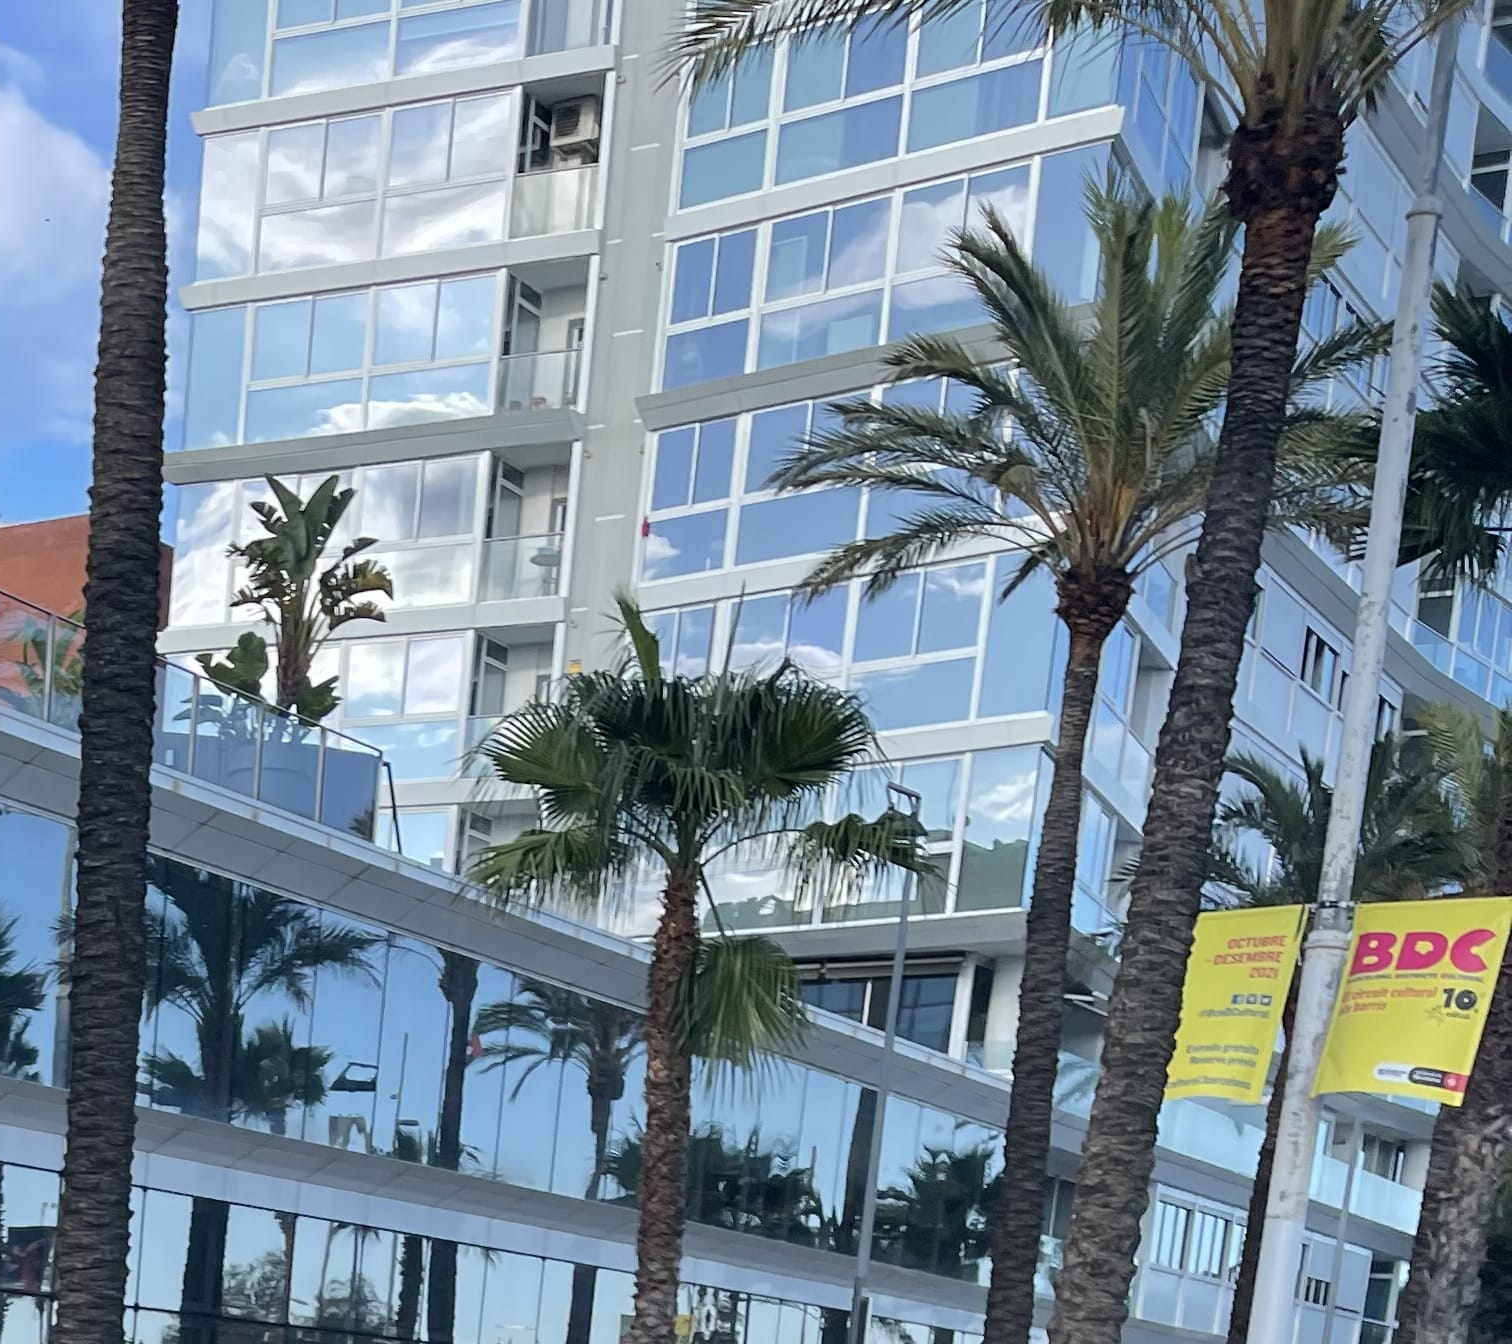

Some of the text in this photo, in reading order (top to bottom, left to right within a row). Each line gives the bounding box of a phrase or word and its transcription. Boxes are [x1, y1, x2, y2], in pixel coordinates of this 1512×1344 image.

[1226, 935, 1288, 950] OCTUBRE
[1213, 951, 1285, 966] DESEMBRE
[1350, 928, 1496, 977] BDC
[1249, 967, 1279, 979] 2021
